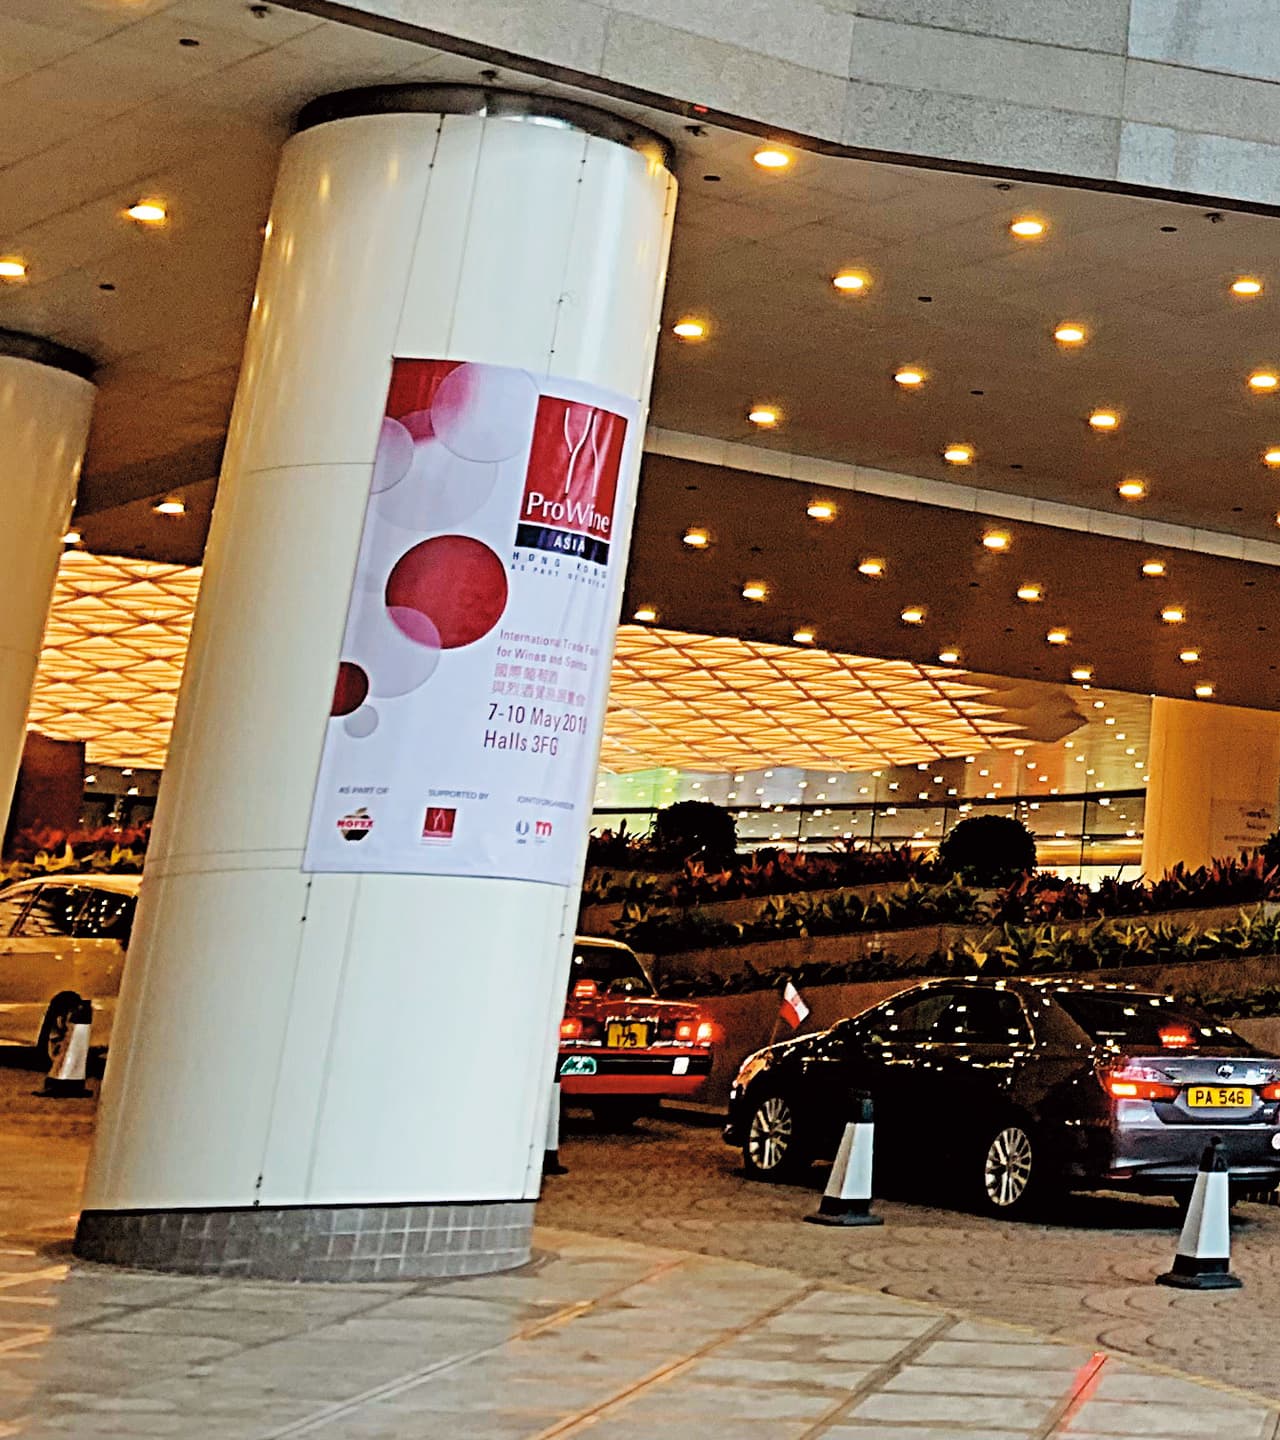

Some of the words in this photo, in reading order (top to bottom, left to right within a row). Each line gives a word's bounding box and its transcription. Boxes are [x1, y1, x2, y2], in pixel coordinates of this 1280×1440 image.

[526, 491, 610, 533] ProWine
[553, 534, 586, 553] ASIA
[496, 645, 512, 658] for
[488, 702, 526, 724] 7-10
[530, 706, 562, 733] May
[483, 728, 528, 752] Halls
[531, 734, 560, 756] 3FG
[428, 788, 478, 800] SUPPORTED
[1195, 1090, 1213, 1105] PA
[1218, 1090, 1245, 1105] 546
